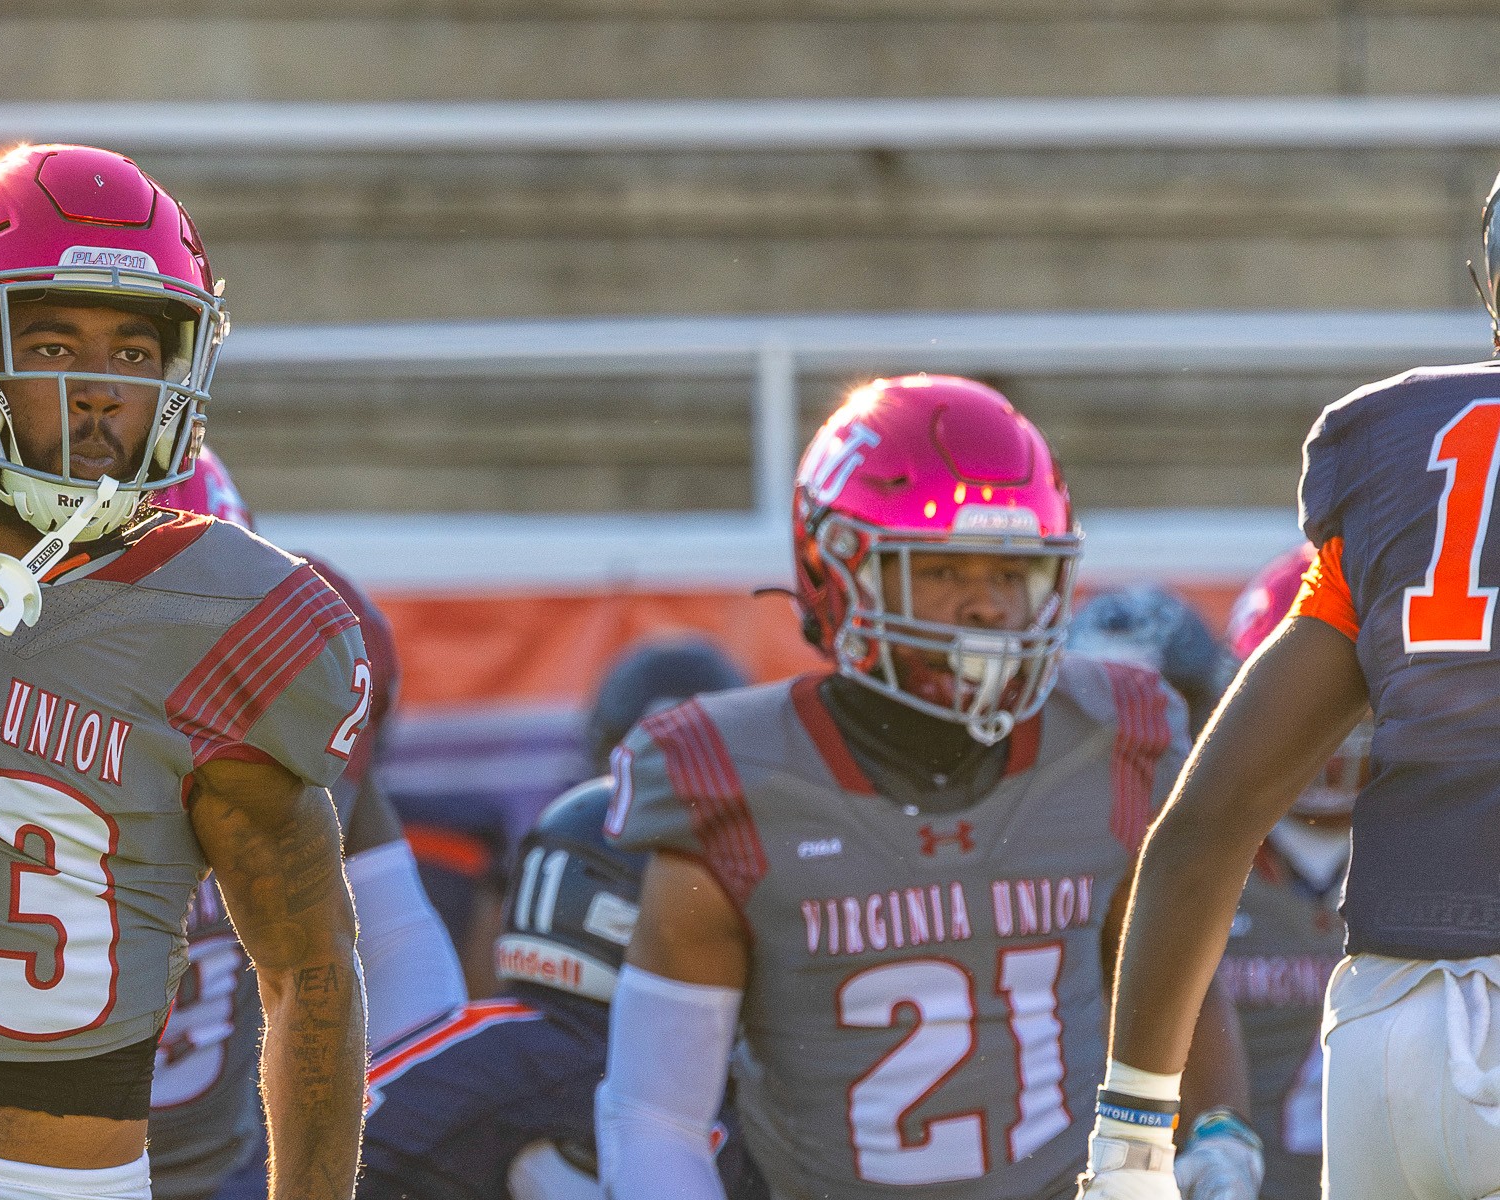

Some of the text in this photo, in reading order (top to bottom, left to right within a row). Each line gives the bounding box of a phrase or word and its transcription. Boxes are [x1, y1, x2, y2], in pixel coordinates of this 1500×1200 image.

[71, 251, 147, 270] PLAY411
[57, 493, 111, 508] Ridll
[29, 541, 60, 572] BATTLE
[0, 677, 133, 787] UNION
[514, 846, 570, 935] 11
[802, 875, 1096, 956] VIRGINIA UNION
[837, 940, 1074, 1186] 21
[1099, 1106, 1135, 1123] TROJA
